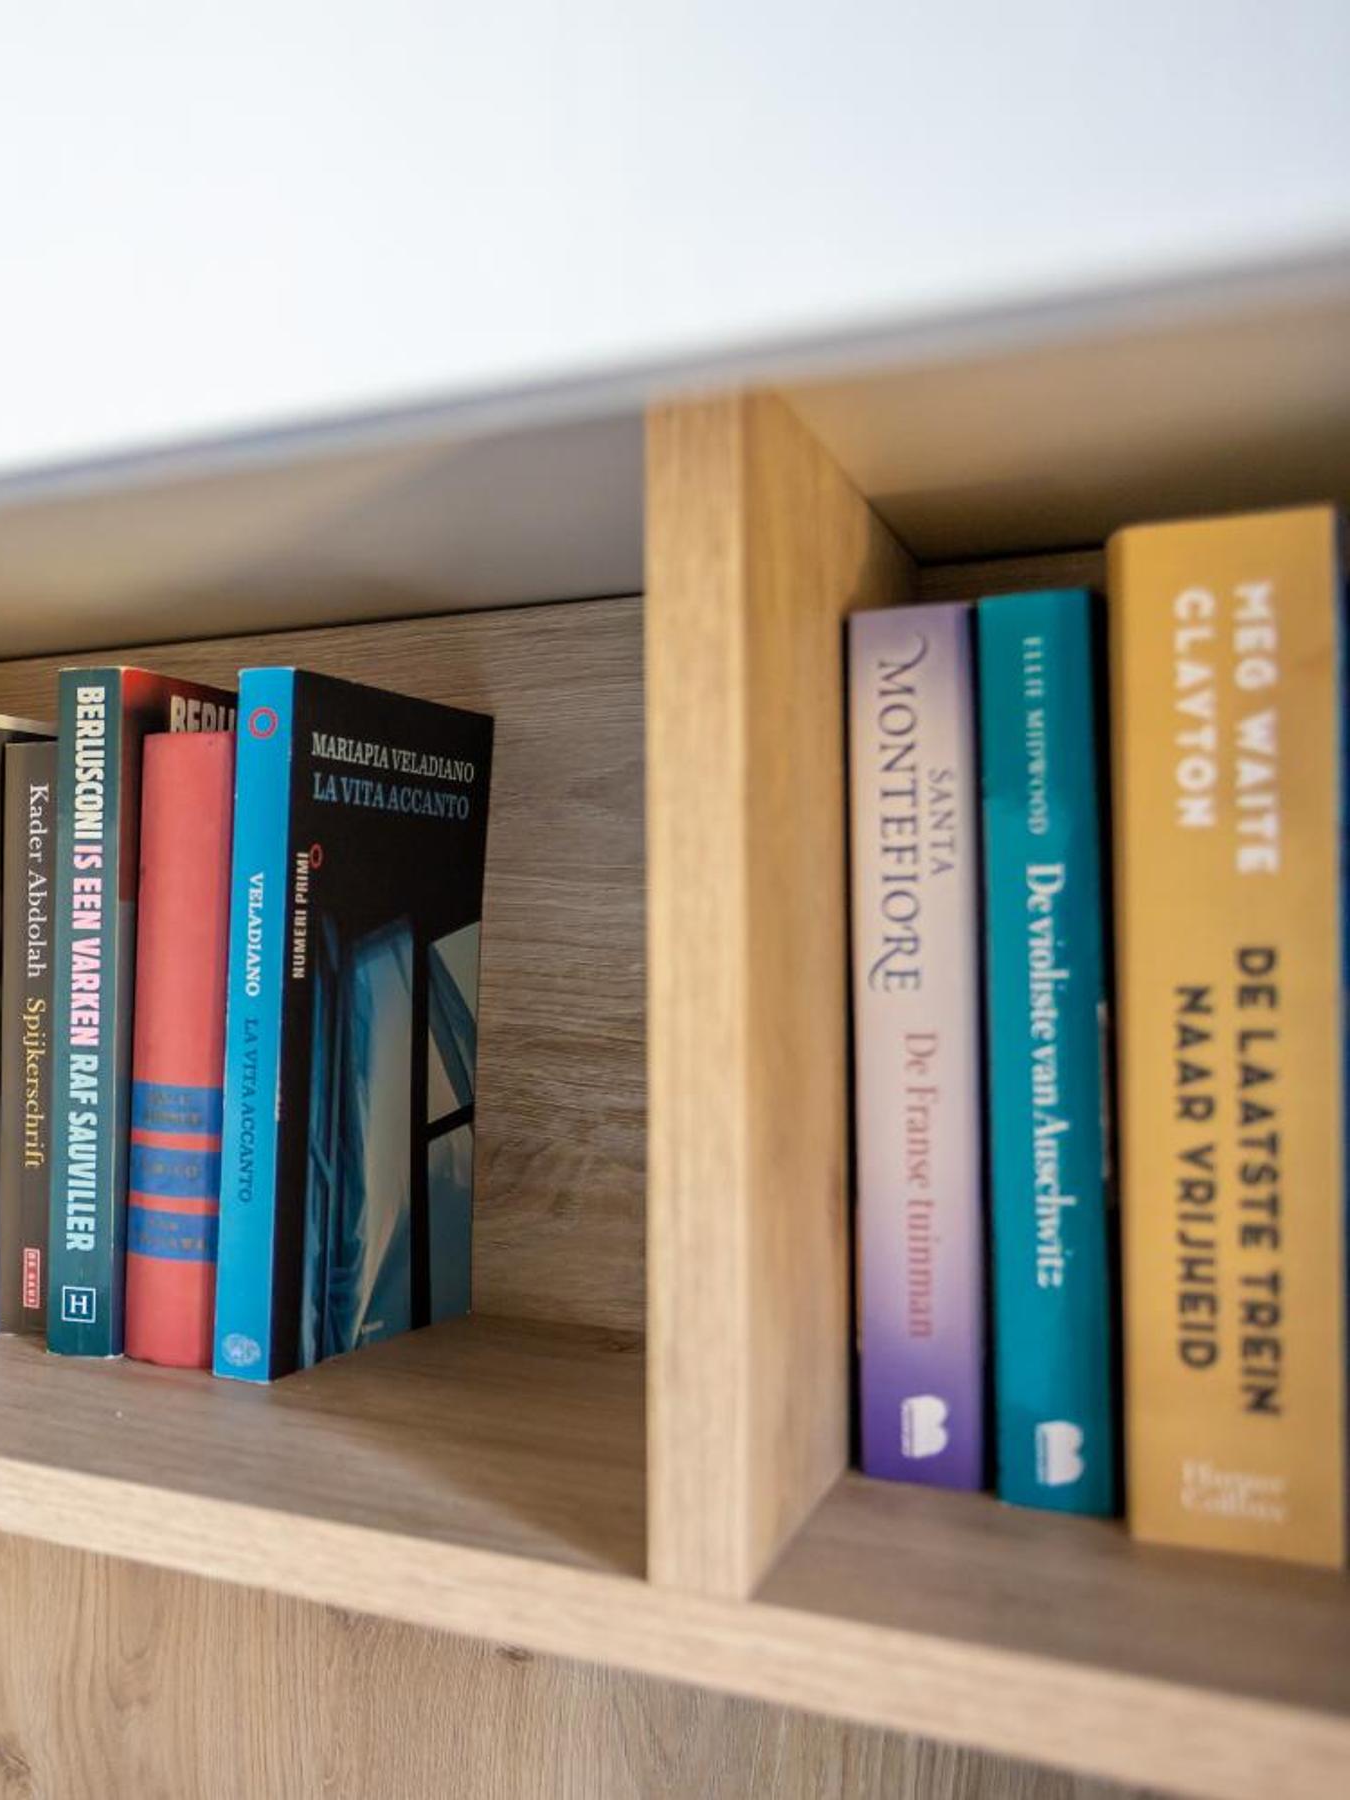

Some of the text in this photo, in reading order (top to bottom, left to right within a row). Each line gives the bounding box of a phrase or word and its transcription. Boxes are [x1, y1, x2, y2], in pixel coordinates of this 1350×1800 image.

[311, 731, 475, 784] MARIAPIA VELADIANO
[313, 771, 470, 821] LA VITA ACCANTO
[1173, 585, 1218, 829] CLAYTON
[1234, 579, 1281, 875] MEG WAITE
[27, 784, 49, 978] Kader Abdolah
[70, 686, 106, 1046] BERLUSCONI IS EEN VARKEN
[868, 630, 929, 992] MONTEFIORE
[928, 767, 955, 877] SANTA
[1026, 862, 1065, 913] De
[245, 872, 264, 997] VELADIANO
[292, 851, 310, 979] NUMERI PRIMI
[23, 998, 46, 1168] Spijkerschrift
[66, 1054, 98, 1251] RAF SAUVILLER
[238, 1018, 259, 1204] LA VITA ACCANTO
[1032, 1045, 1058, 1107] van
[904, 1031, 941, 1338] De Franse tuinman
[1033, 1111, 1077, 1290] Auschwitz
[1176, 984, 1219, 1371] NAAR VRIJHEID
[1237, 946, 1282, 1416] DE LAATSTE TREIN
[69, 1293, 88, 1315] H
